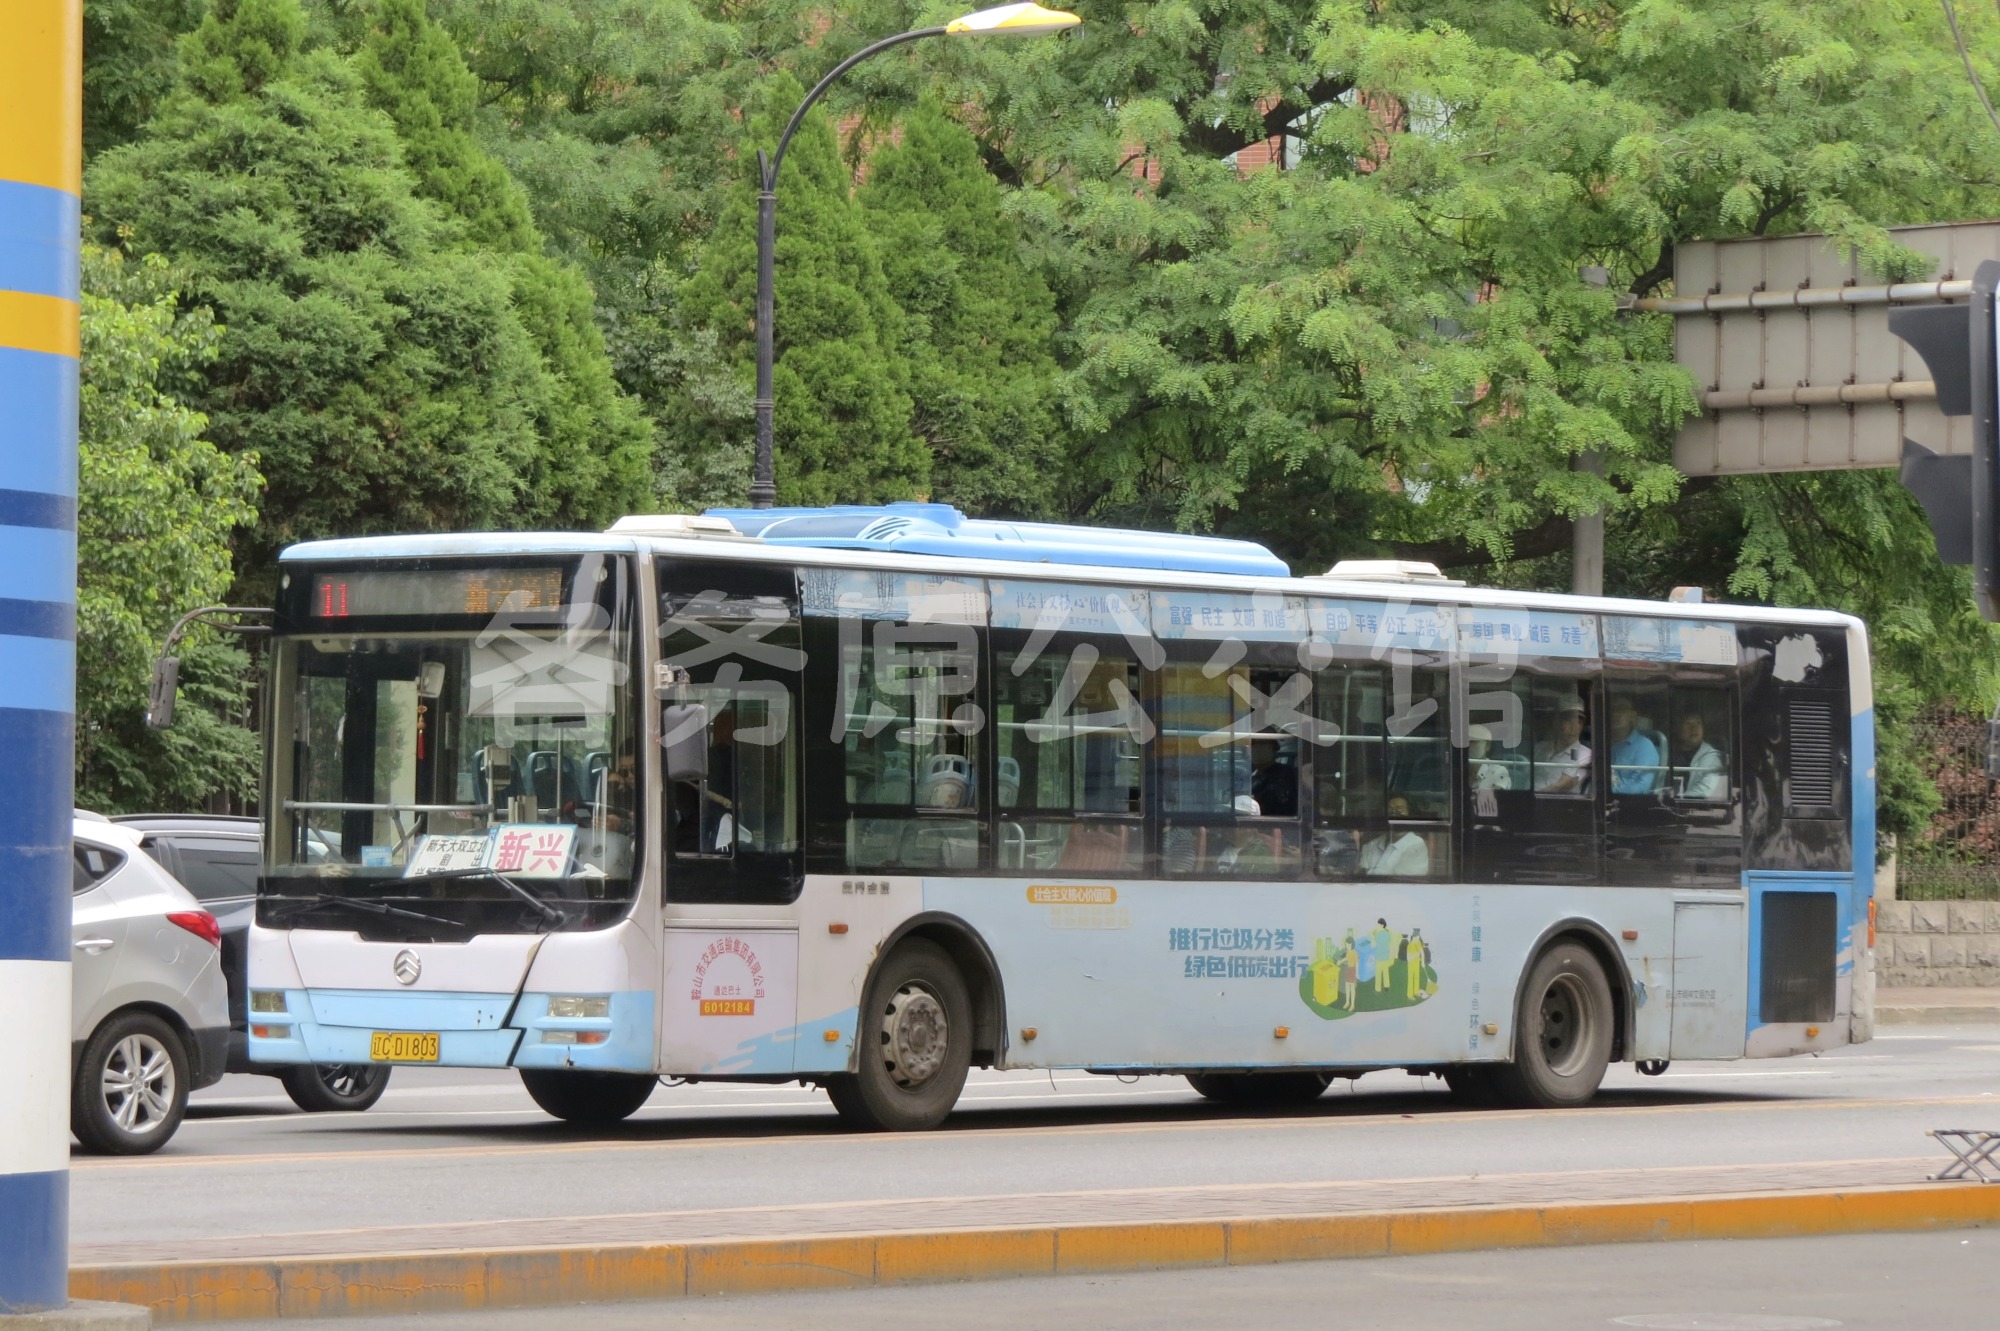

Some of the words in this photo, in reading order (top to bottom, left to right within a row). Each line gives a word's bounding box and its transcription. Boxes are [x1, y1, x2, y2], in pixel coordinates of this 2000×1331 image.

[320, 583, 348, 617] 11
[1170, 606, 1192, 626] 富强
[1201, 607, 1224, 627] 民主
[1232, 608, 1256, 628] 文明
[1263, 609, 1285, 629] 和谐
[1326, 612, 1348, 632] 自由
[1355, 614, 1377, 634] 平等
[1386, 615, 1407, 636] 公正
[1415, 617, 1437, 637] 法治
[1472, 622, 1494, 640] 爱国
[1501, 623, 1522, 642] 敬业
[1529, 624, 1550, 643] 诚信
[1560, 626, 1581, 645] 友善
[495, 831, 564, 872] 新兴
[1033, 887, 1112, 902] 社会主义核心价值观
[1169, 927, 1294, 951] 推行垃圾分类
[690, 936, 765, 1000] 鞍山市交通运输集团有限公司
[1184, 955, 1309, 978] 绿色低碳出行
[713, 985, 741, 996] 通达巴士
[704, 1001, 750, 1013] 6012184
